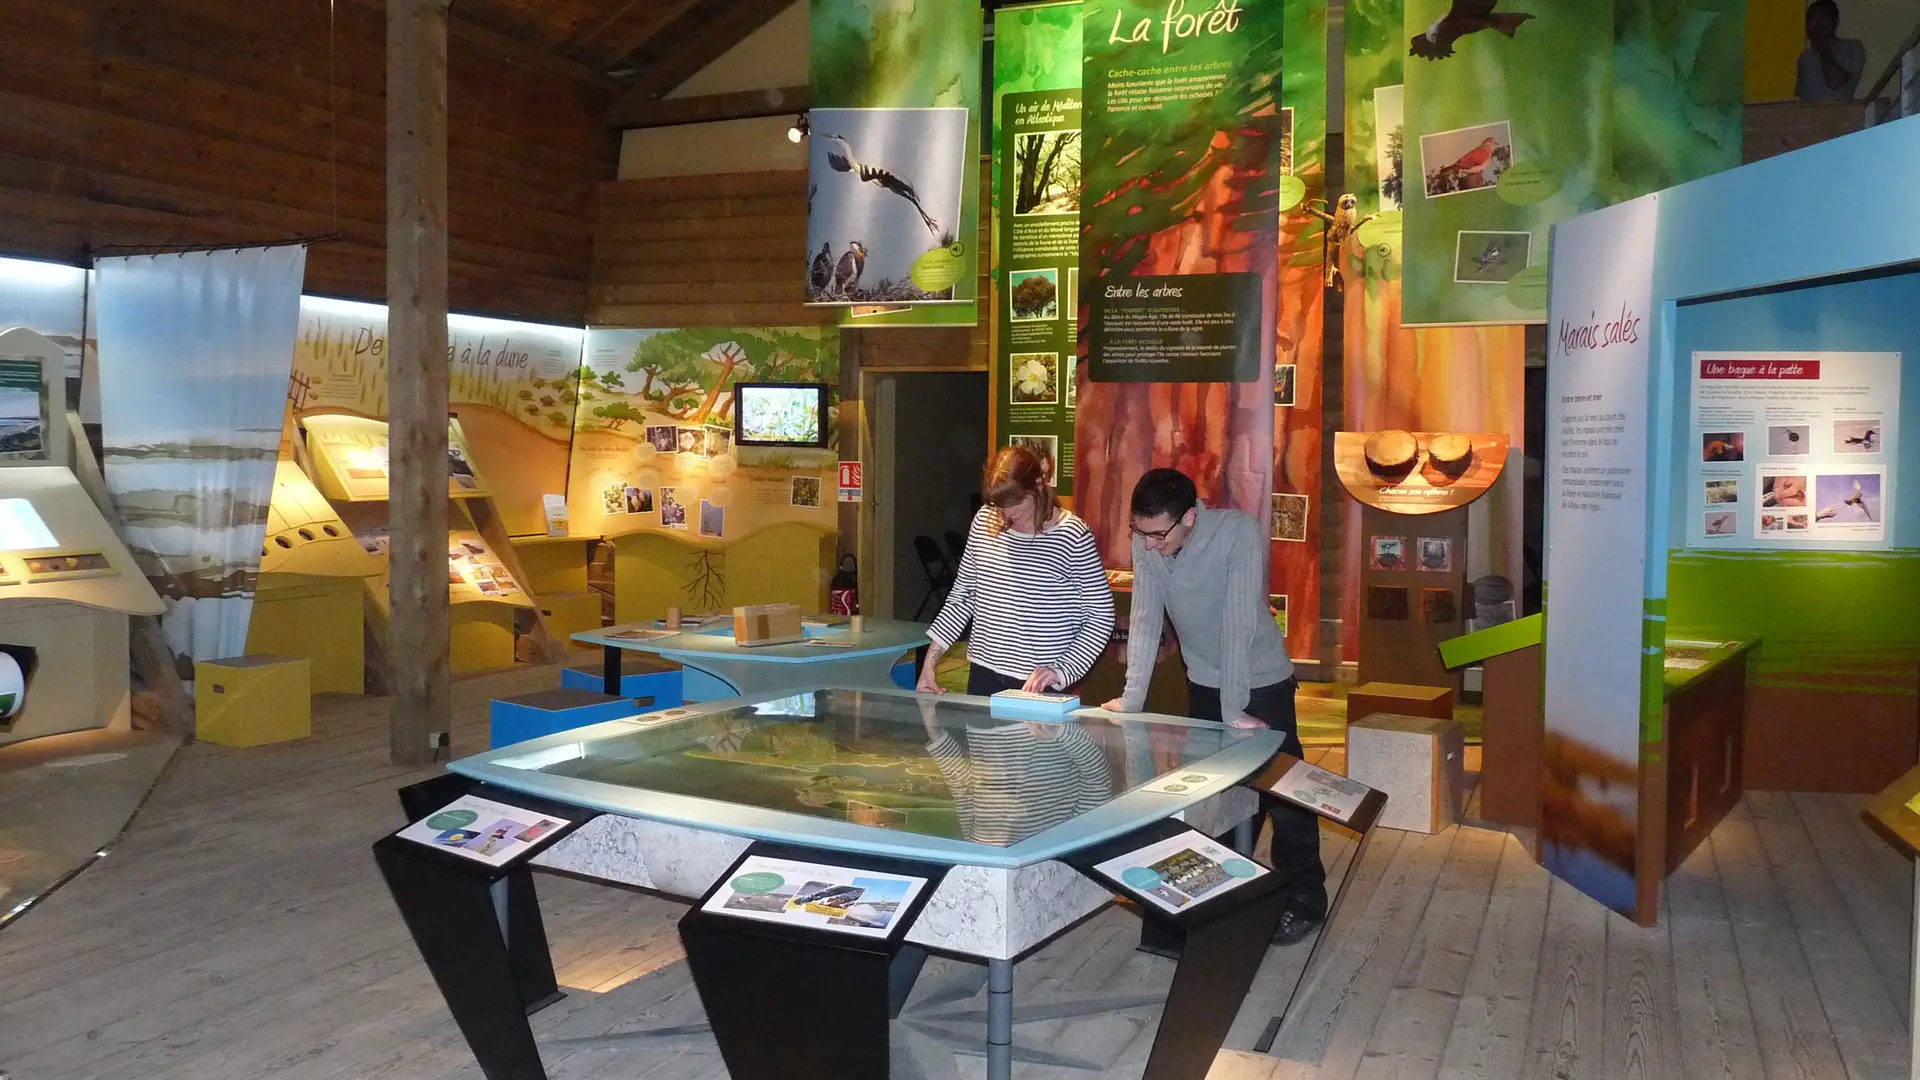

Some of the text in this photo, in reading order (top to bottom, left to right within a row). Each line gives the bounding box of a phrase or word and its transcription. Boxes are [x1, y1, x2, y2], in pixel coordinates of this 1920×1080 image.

[1108, 0, 1243, 54] La forêt
[1108, 60, 1232, 78] Cache-cache entre les arbres
[1015, 103, 1026, 114] Un
[1028, 101, 1040, 112] air
[1040, 100, 1050, 112] de
[1014, 112, 1064, 126] en Atlantique
[1104, 282, 1184, 298] Entre les arbres
[1556, 299, 1641, 357] Marais salés
[355, 326, 384, 356] De
[460, 340, 472, 365] à
[476, 334, 492, 366] la
[496, 337, 529, 369] dune
[1706, 362, 1804, 379] Une bague à la patte
[1586, 394, 1592, 402] et
